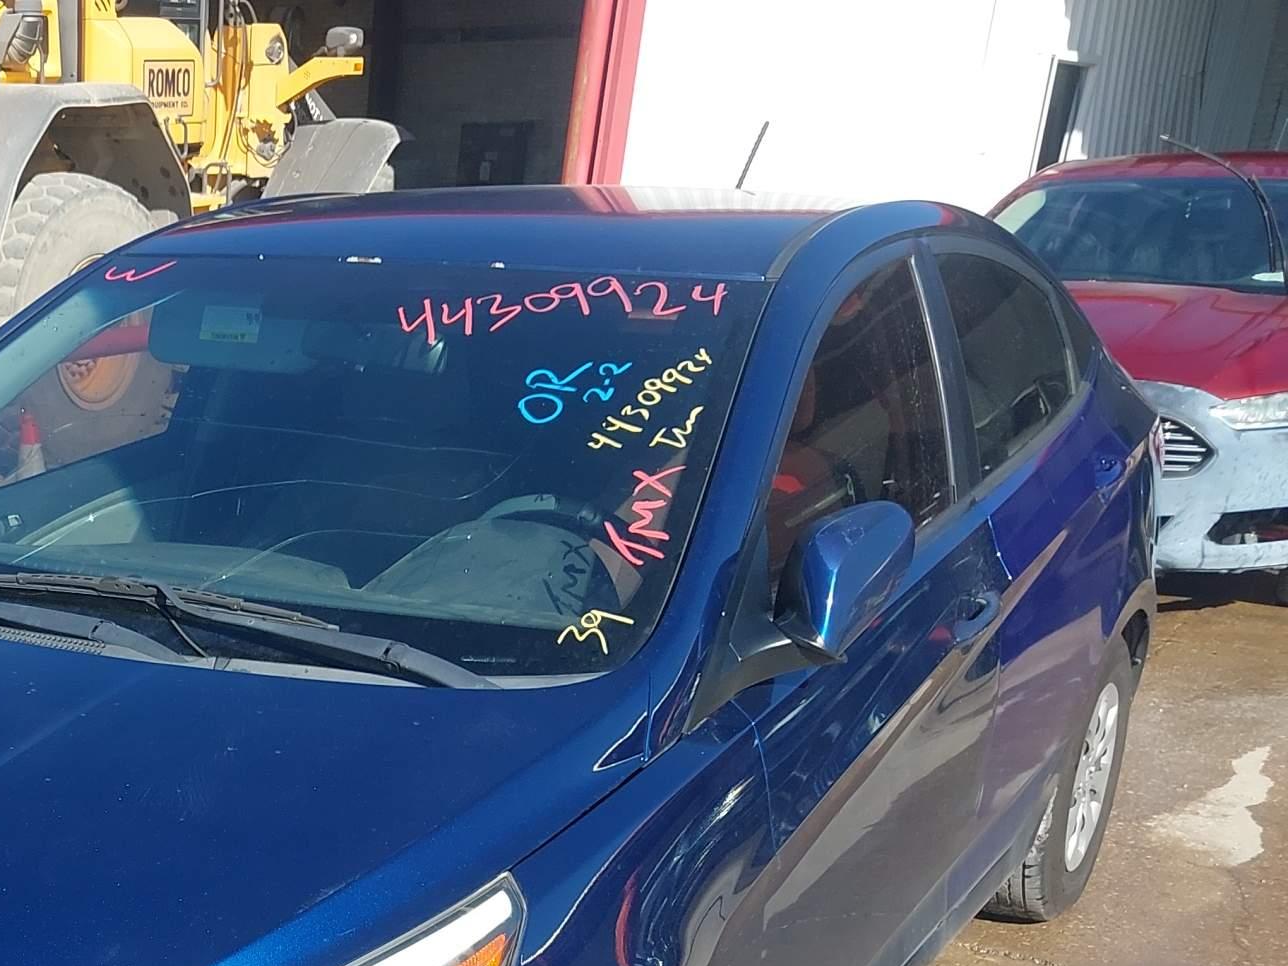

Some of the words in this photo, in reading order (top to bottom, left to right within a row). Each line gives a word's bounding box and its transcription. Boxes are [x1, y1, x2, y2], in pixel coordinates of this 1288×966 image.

[148, 67, 190, 98] ROMCO
[397, 276, 729, 346] 44309924
[587, 347, 713, 449] 44309924
[557, 608, 635, 656] 39
